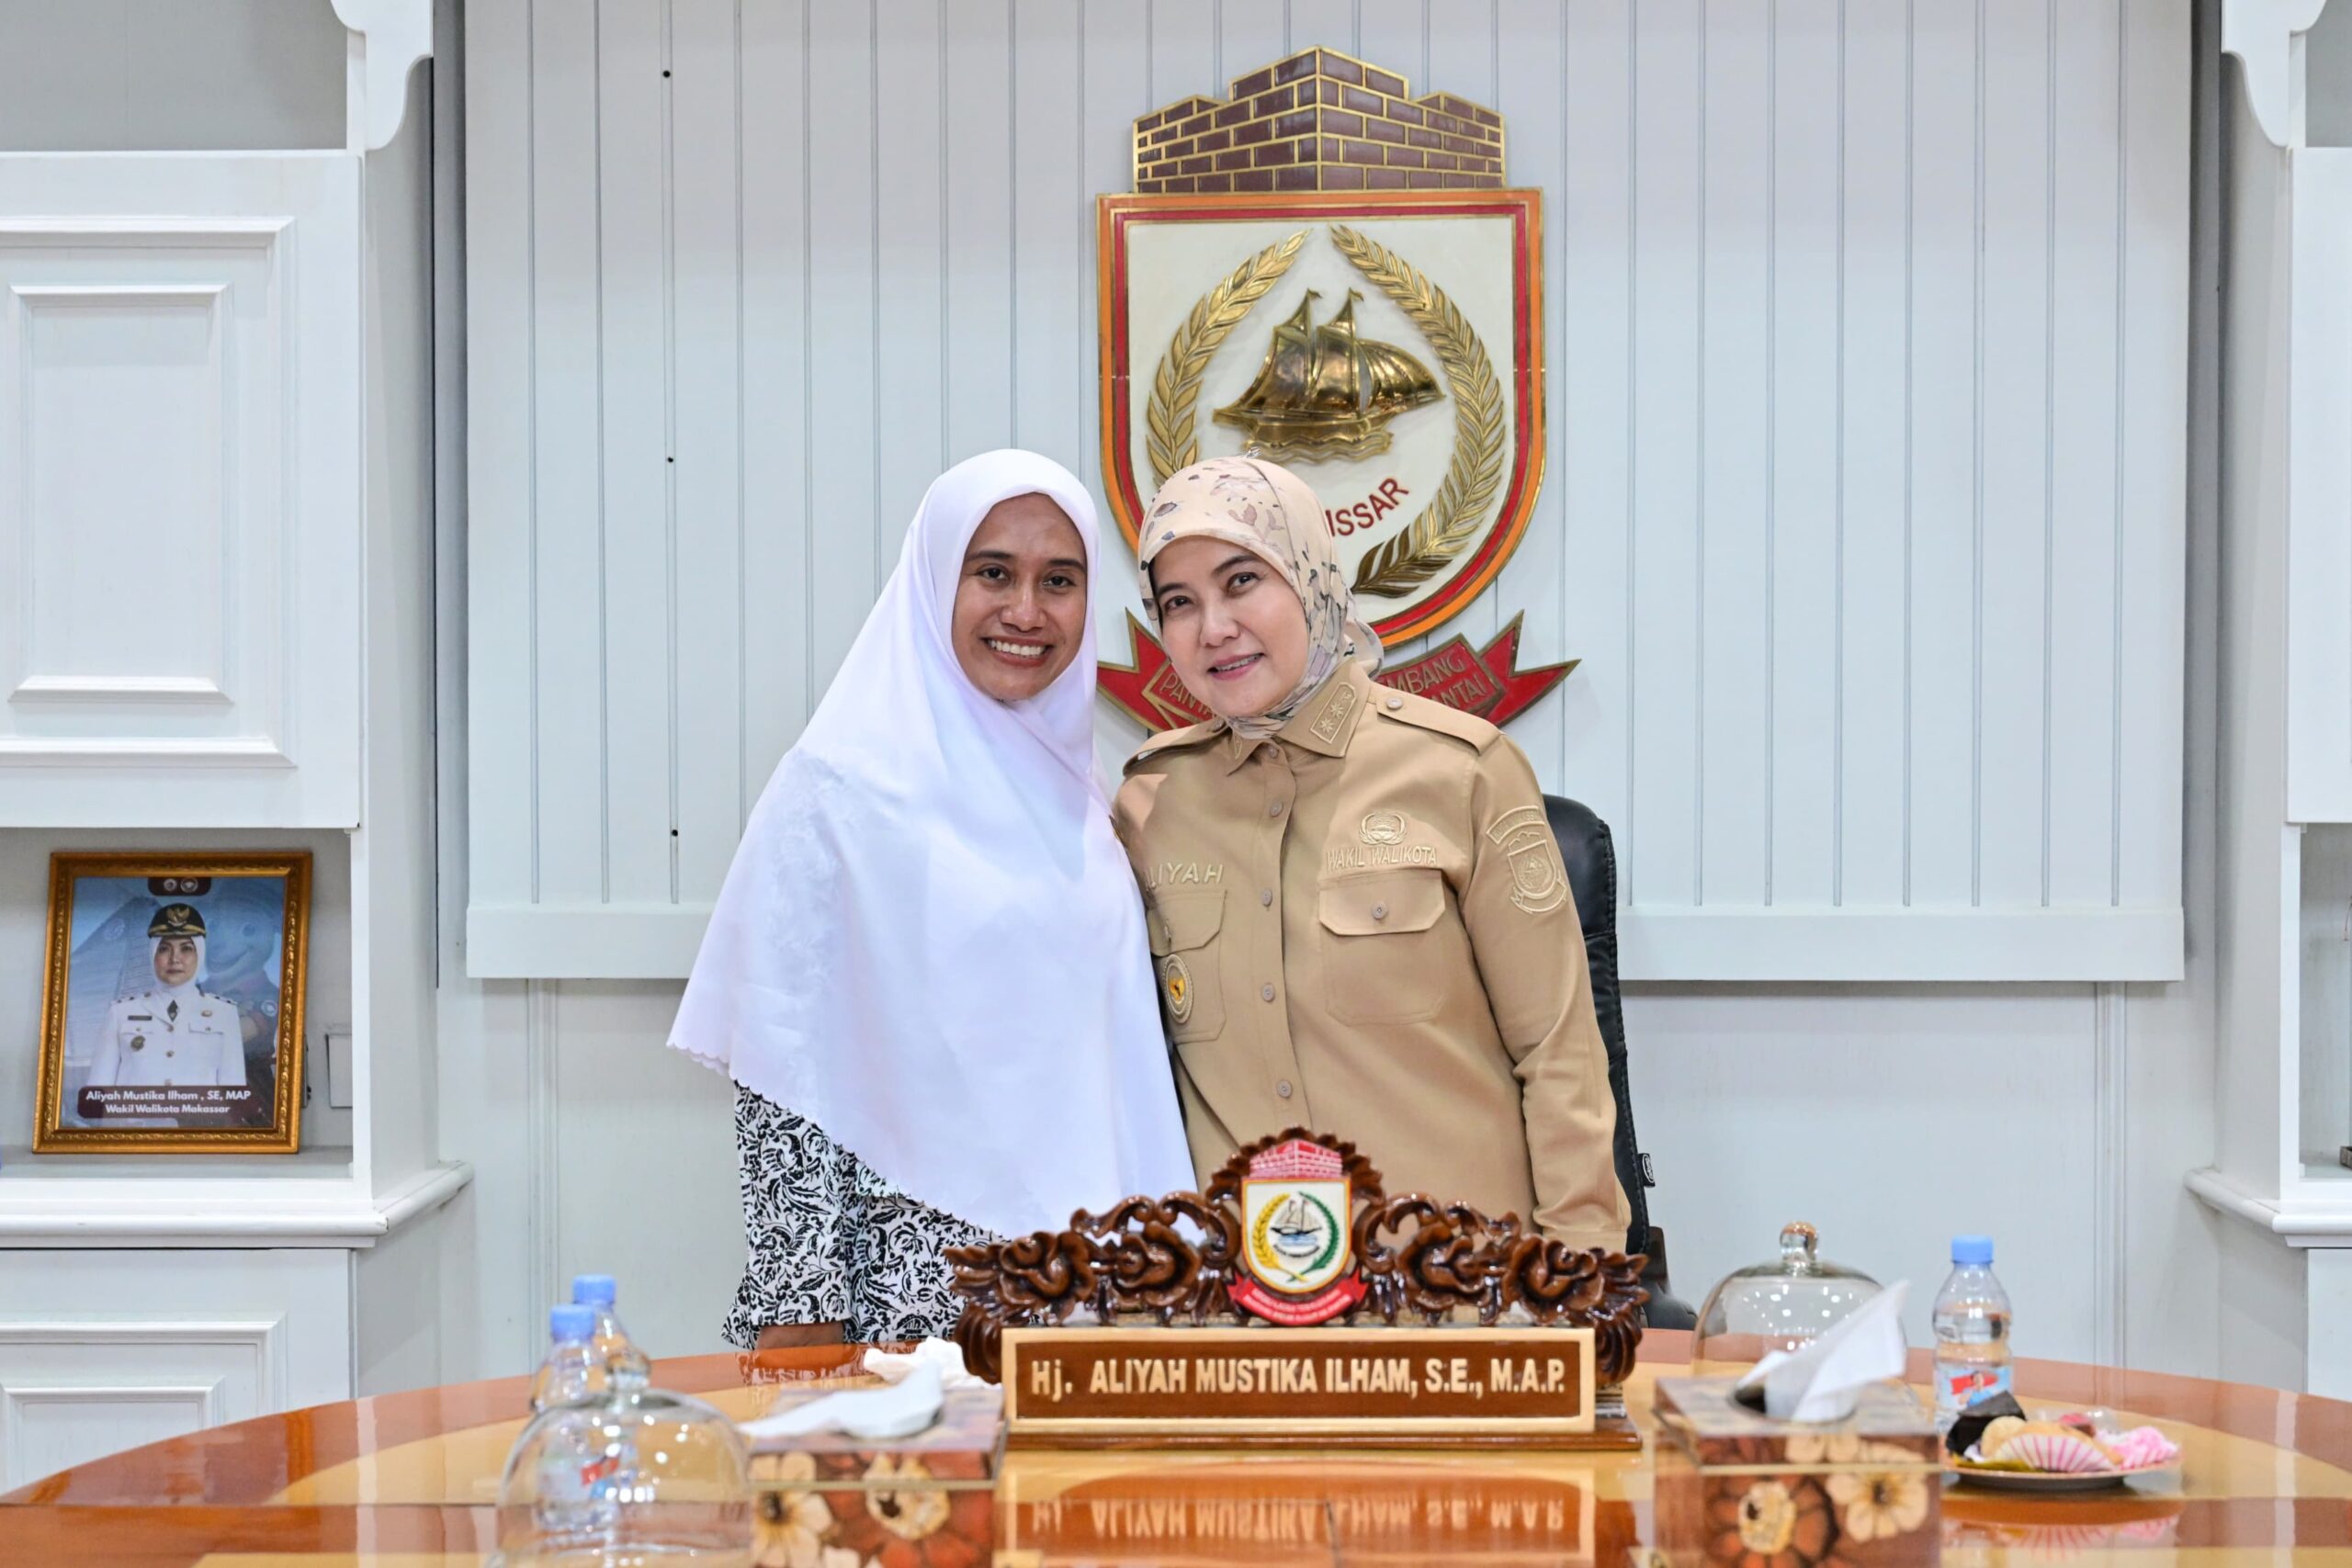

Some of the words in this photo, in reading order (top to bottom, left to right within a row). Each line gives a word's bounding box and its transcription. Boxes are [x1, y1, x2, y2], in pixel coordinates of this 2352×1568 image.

[1325, 478, 1409, 537] SSAR
[1379, 651, 1465, 694] MBANG
[1431, 673, 1487, 708] NTAI
[1327, 847, 1365, 872] WAKIL
[1372, 845, 1437, 865] WALIKOTA
[1146, 863, 1223, 888] LIYAH
[86, 1090, 120, 1102] Aliyah
[123, 1090, 165, 1100] Mustika
[207, 1090, 223, 1101] SE,
[225, 1090, 251, 1100] MAP
[106, 1104, 134, 1113] Wakil
[135, 1104, 179, 1113] Walikota
[181, 1104, 230, 1113] Makassar
[1031, 1359, 1073, 1403] Hj.
[1090, 1359, 1187, 1393] ALIYAH
[1195, 1359, 1317, 1393] MUSTIKA
[1326, 1359, 1418, 1399] ILHAM,
[1425, 1359, 1483, 1399] S.E.,
